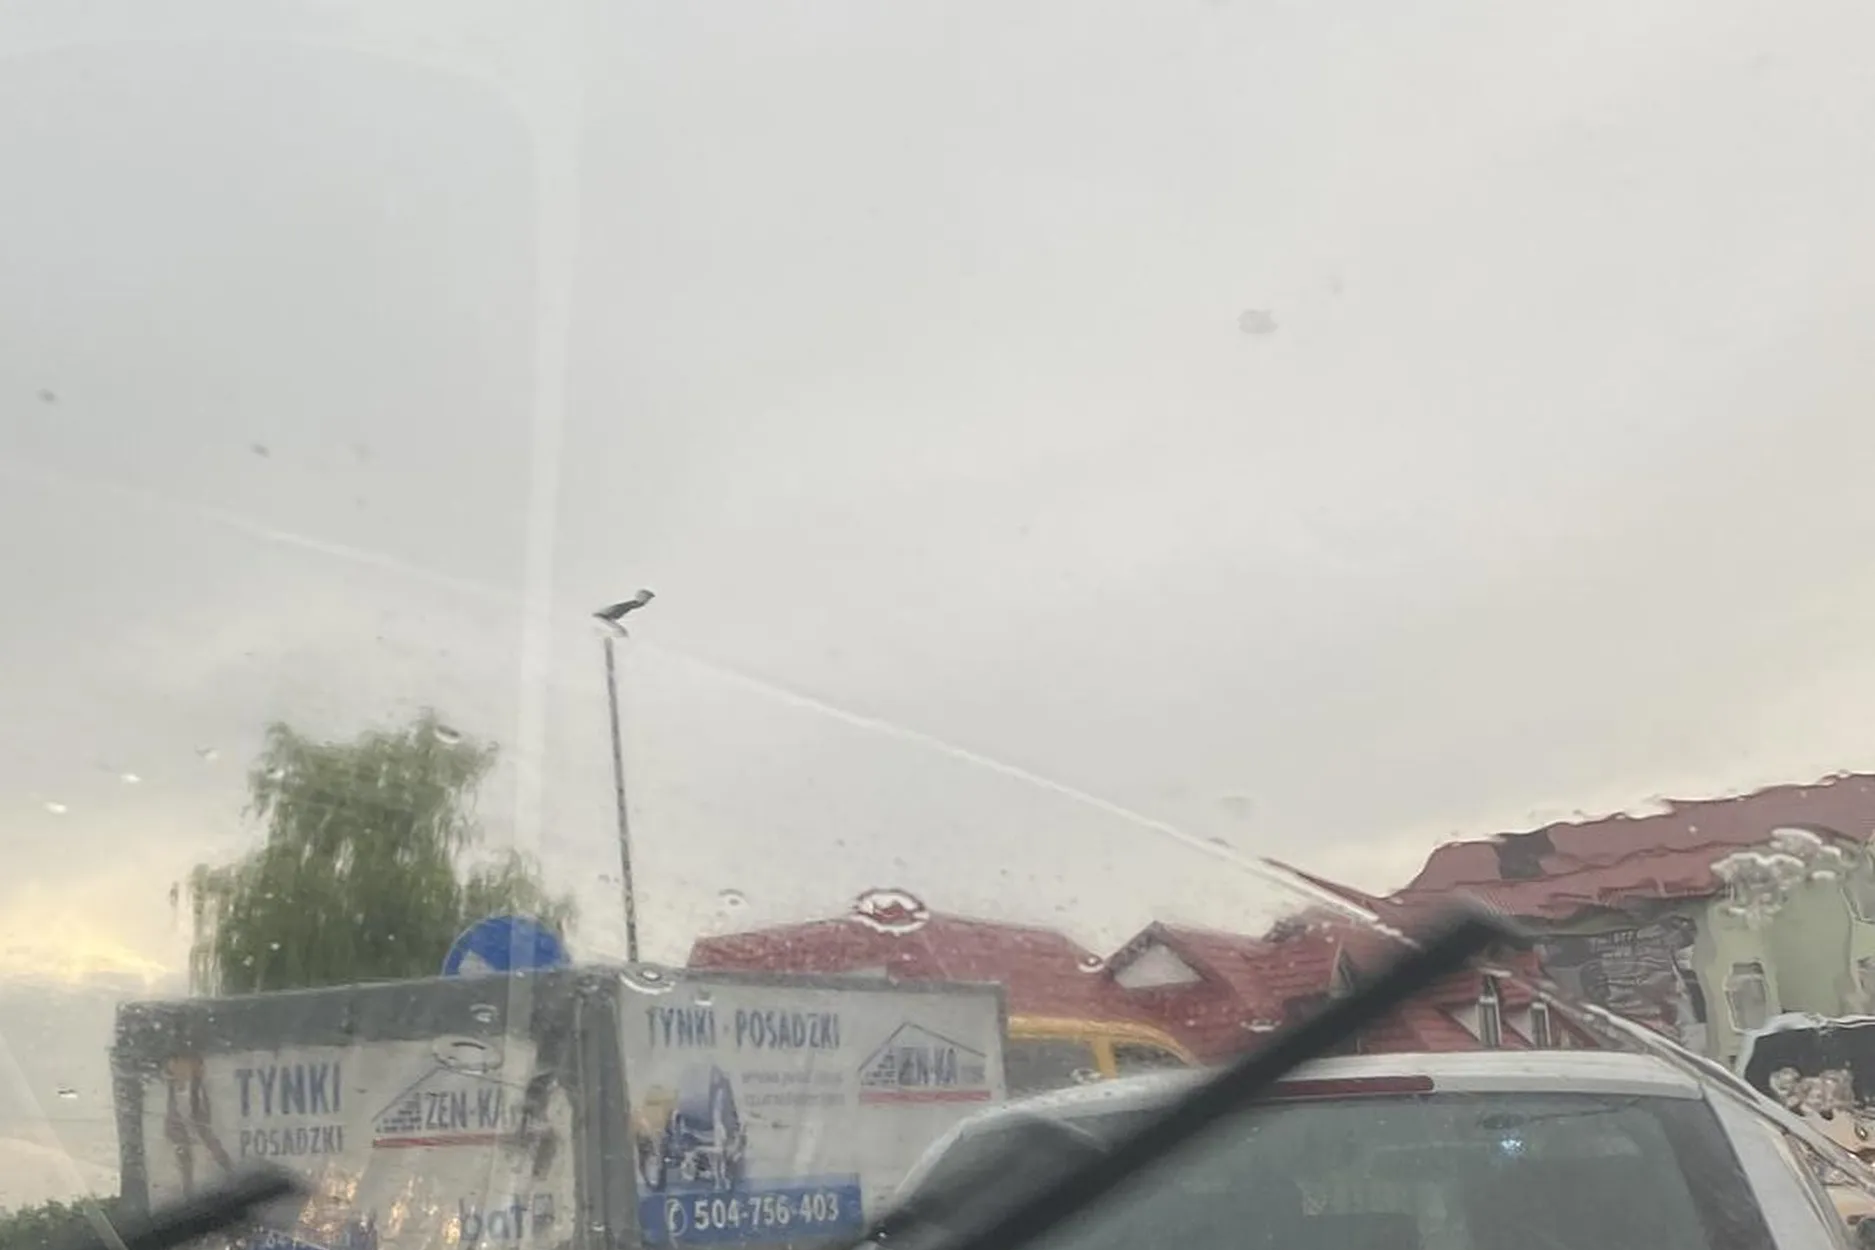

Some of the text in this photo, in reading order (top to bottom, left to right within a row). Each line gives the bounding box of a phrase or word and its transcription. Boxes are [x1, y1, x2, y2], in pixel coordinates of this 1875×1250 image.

[645, 1007, 840, 1049] TYNKI POSADZKI
[234, 1064, 341, 1117] TYNKI
[240, 1124, 344, 1157] POSADZKI
[694, 1193, 839, 1230] 504-756-403
